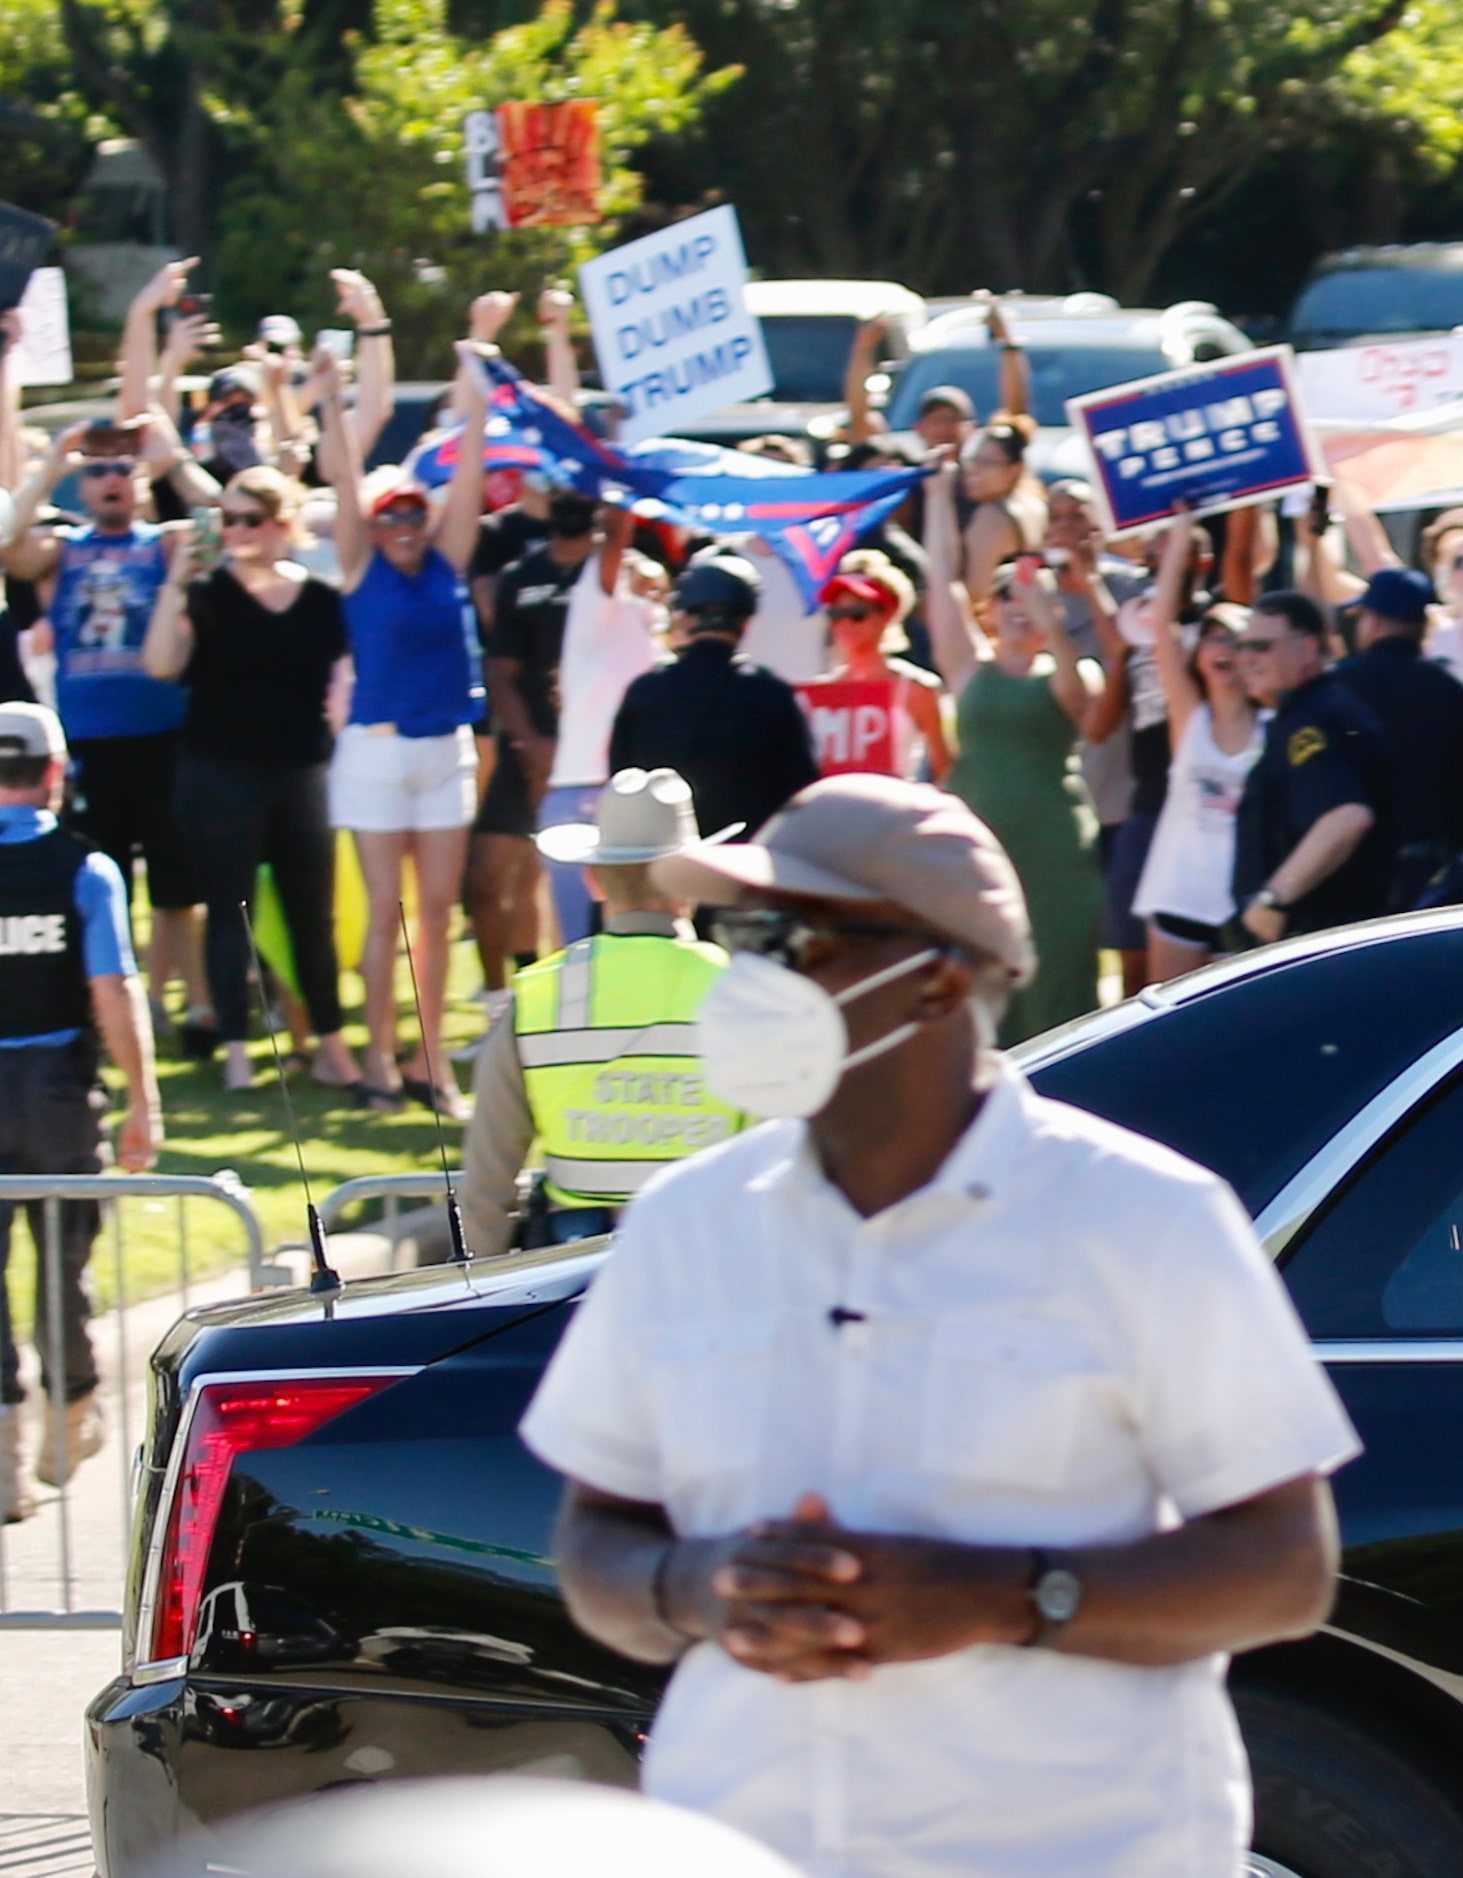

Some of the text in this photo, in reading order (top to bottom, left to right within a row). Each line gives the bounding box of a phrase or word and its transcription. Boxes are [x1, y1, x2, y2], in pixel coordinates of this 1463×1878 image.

[607, 235, 717, 306] DUMP
[618, 288, 732, 360] DUMB
[618, 335, 752, 420] TRUMP
[1093, 388, 1287, 461] TRUMP
[1117, 421, 1281, 480] PENCE
[595, 1070, 703, 1106] STATE
[563, 1110, 728, 1147] TROOPER
